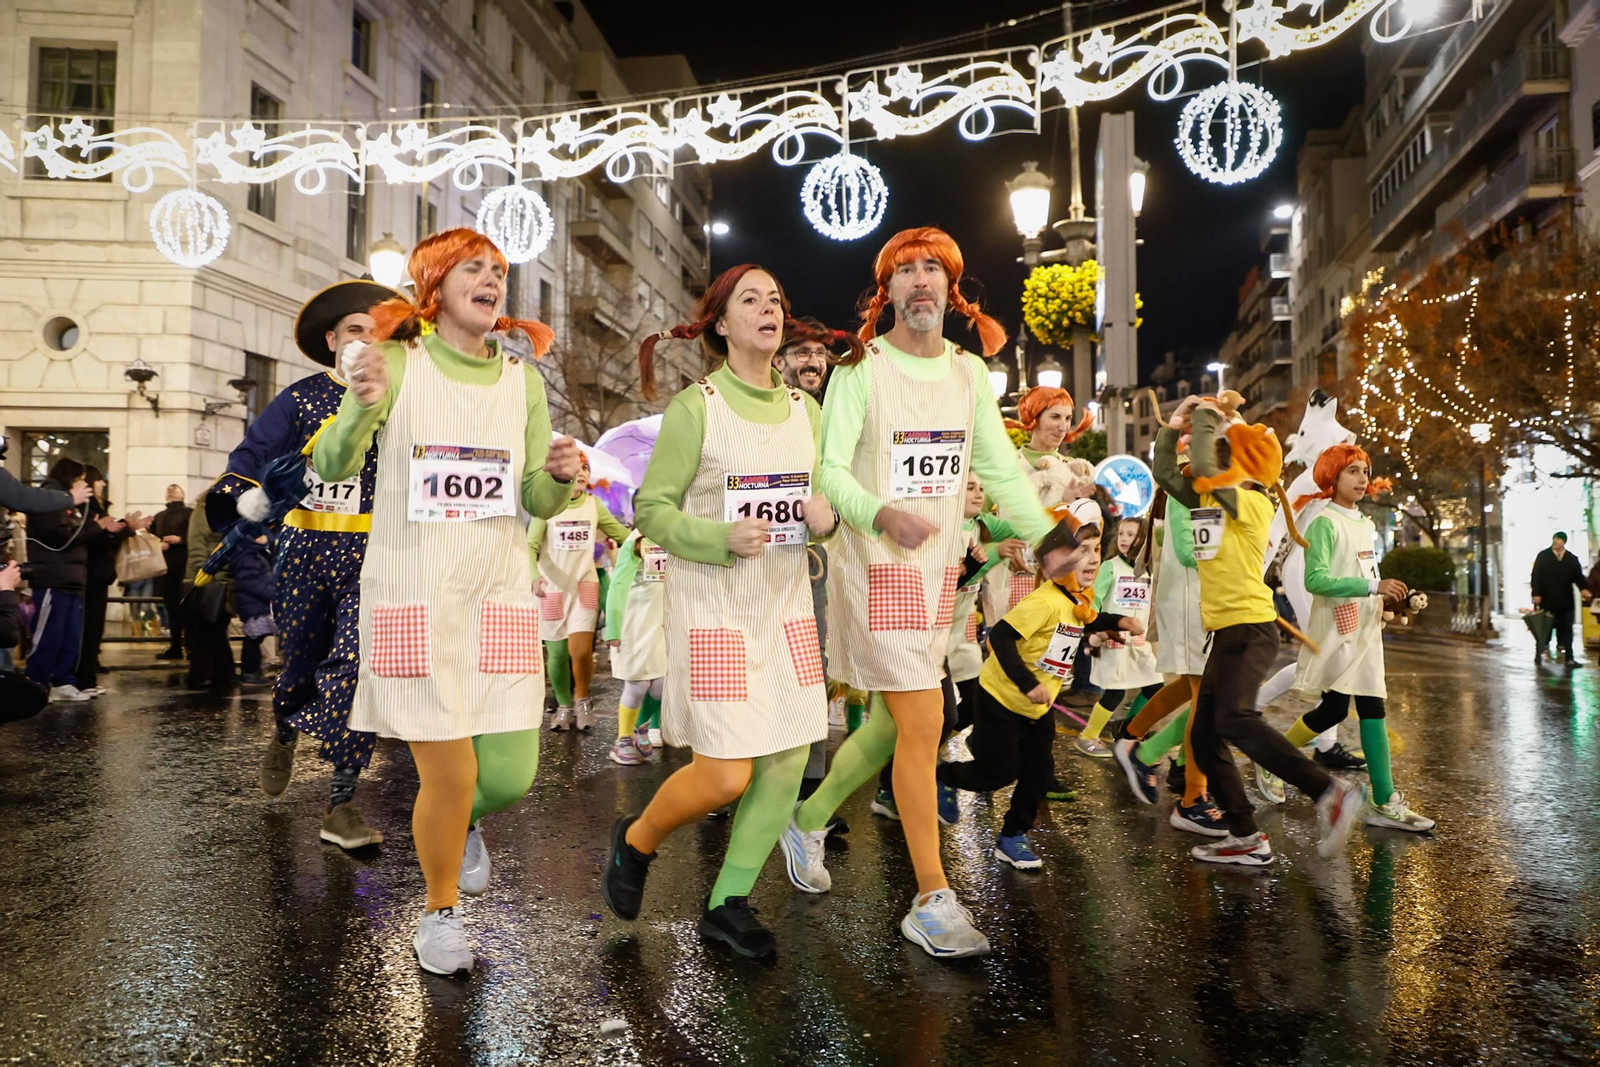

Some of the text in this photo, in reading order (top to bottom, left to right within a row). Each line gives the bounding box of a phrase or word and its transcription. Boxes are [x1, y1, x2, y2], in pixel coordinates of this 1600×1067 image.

[894, 431, 905, 444] 33
[903, 454, 960, 476] 1678
[423, 472, 503, 499] 1602
[728, 475, 740, 489] 33
[738, 481, 770, 489] NOCTURNA
[738, 499, 805, 523] 1680
[559, 531, 589, 541] 1485
[1123, 587, 1146, 599] 243
